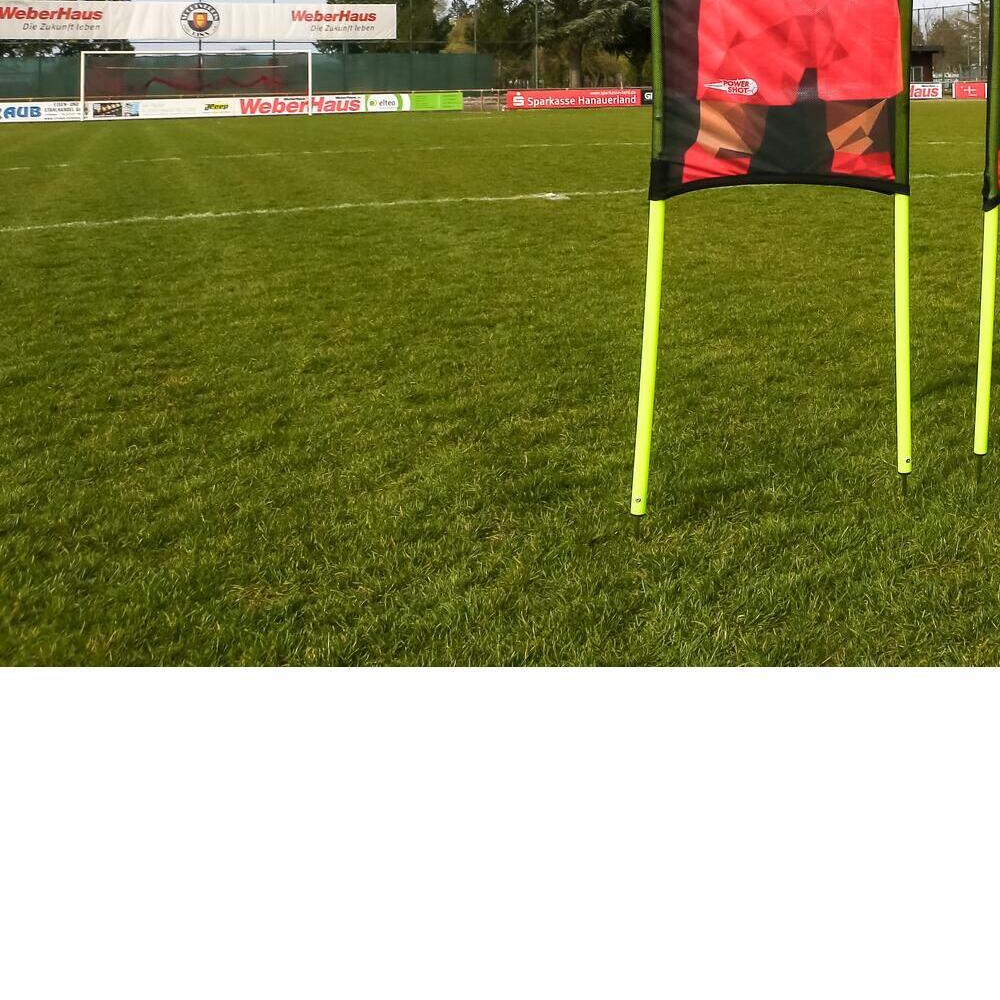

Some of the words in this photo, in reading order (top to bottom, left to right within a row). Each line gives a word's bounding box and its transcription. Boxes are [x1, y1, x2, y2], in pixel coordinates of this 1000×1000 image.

[0, 7, 103, 20] WeberHaus
[290, 10, 377, 22] WeberHaus
[240, 96, 361, 114] WeberHaus
[527, 96, 576, 107] Sparkasse
[578, 95, 637, 105] Hanauerland
[0, 106, 41, 119] AUB
